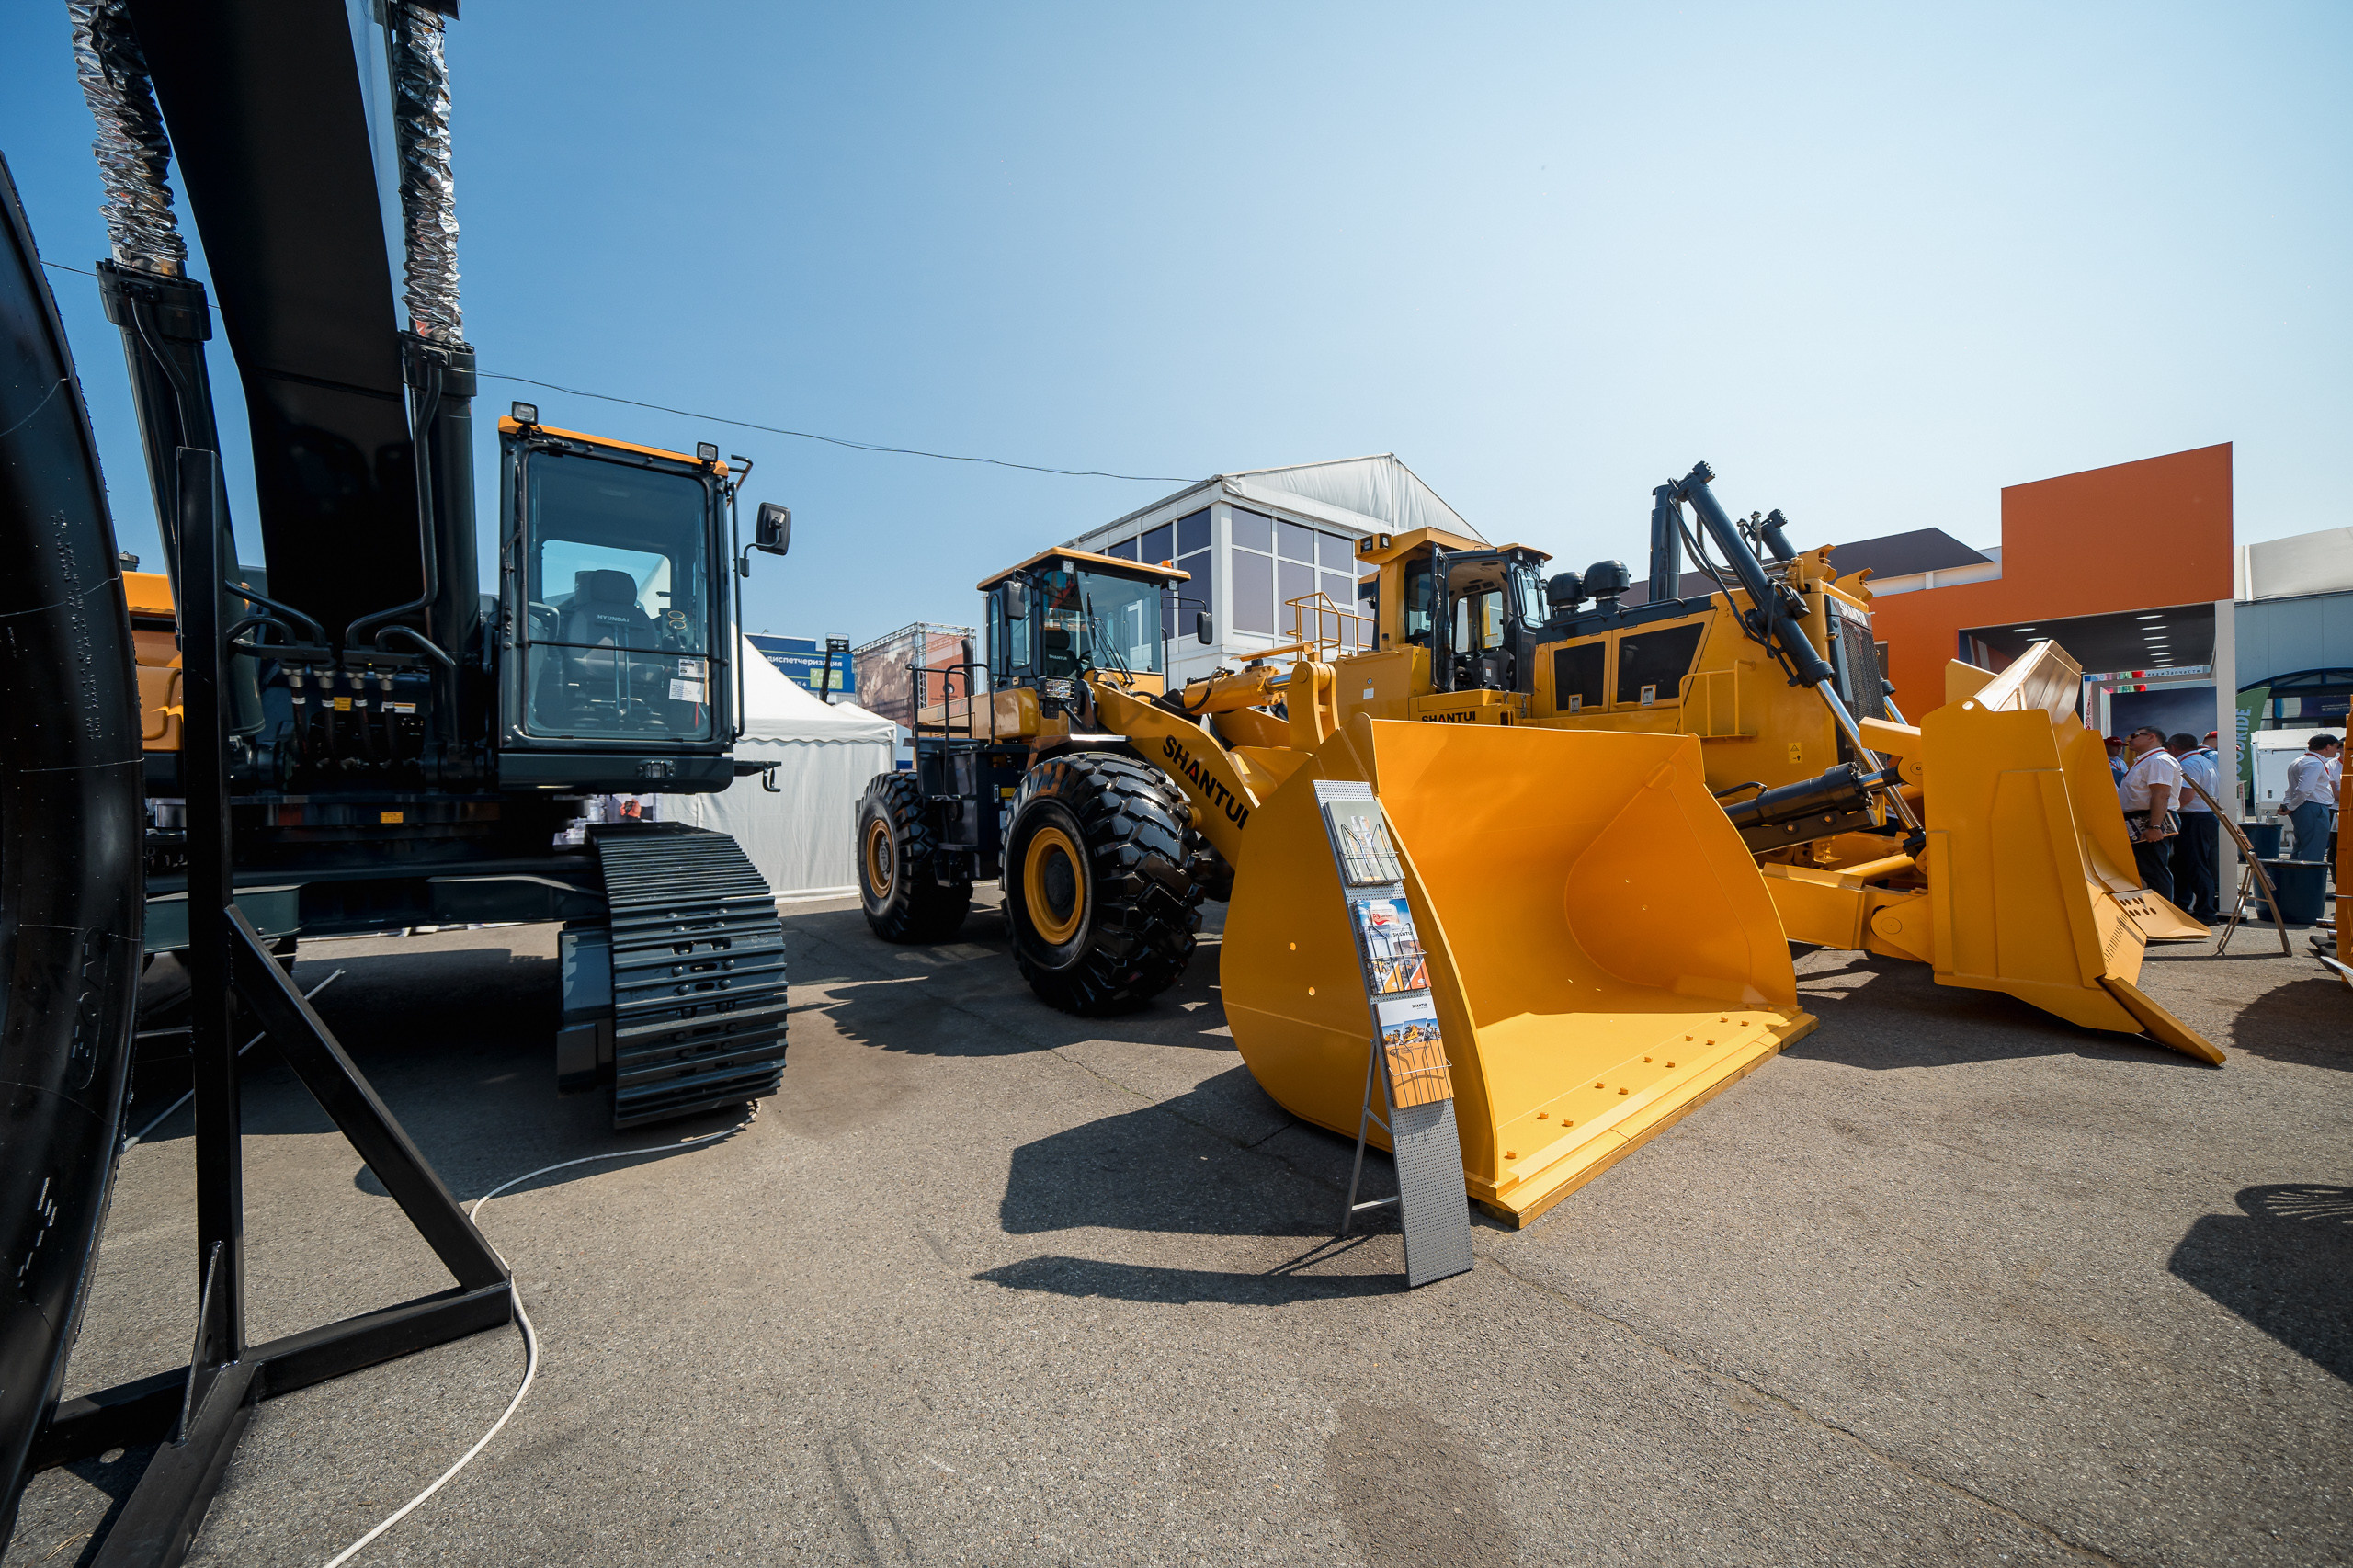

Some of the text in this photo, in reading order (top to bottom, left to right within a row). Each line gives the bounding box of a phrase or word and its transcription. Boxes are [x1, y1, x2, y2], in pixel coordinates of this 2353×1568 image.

[597, 614, 630, 622] HYUNDAI
[1422, 711, 1475, 722] SHANTUI
[2235, 708, 2252, 781] ODRIDE
[1163, 734, 1250, 831] SHANTUI
